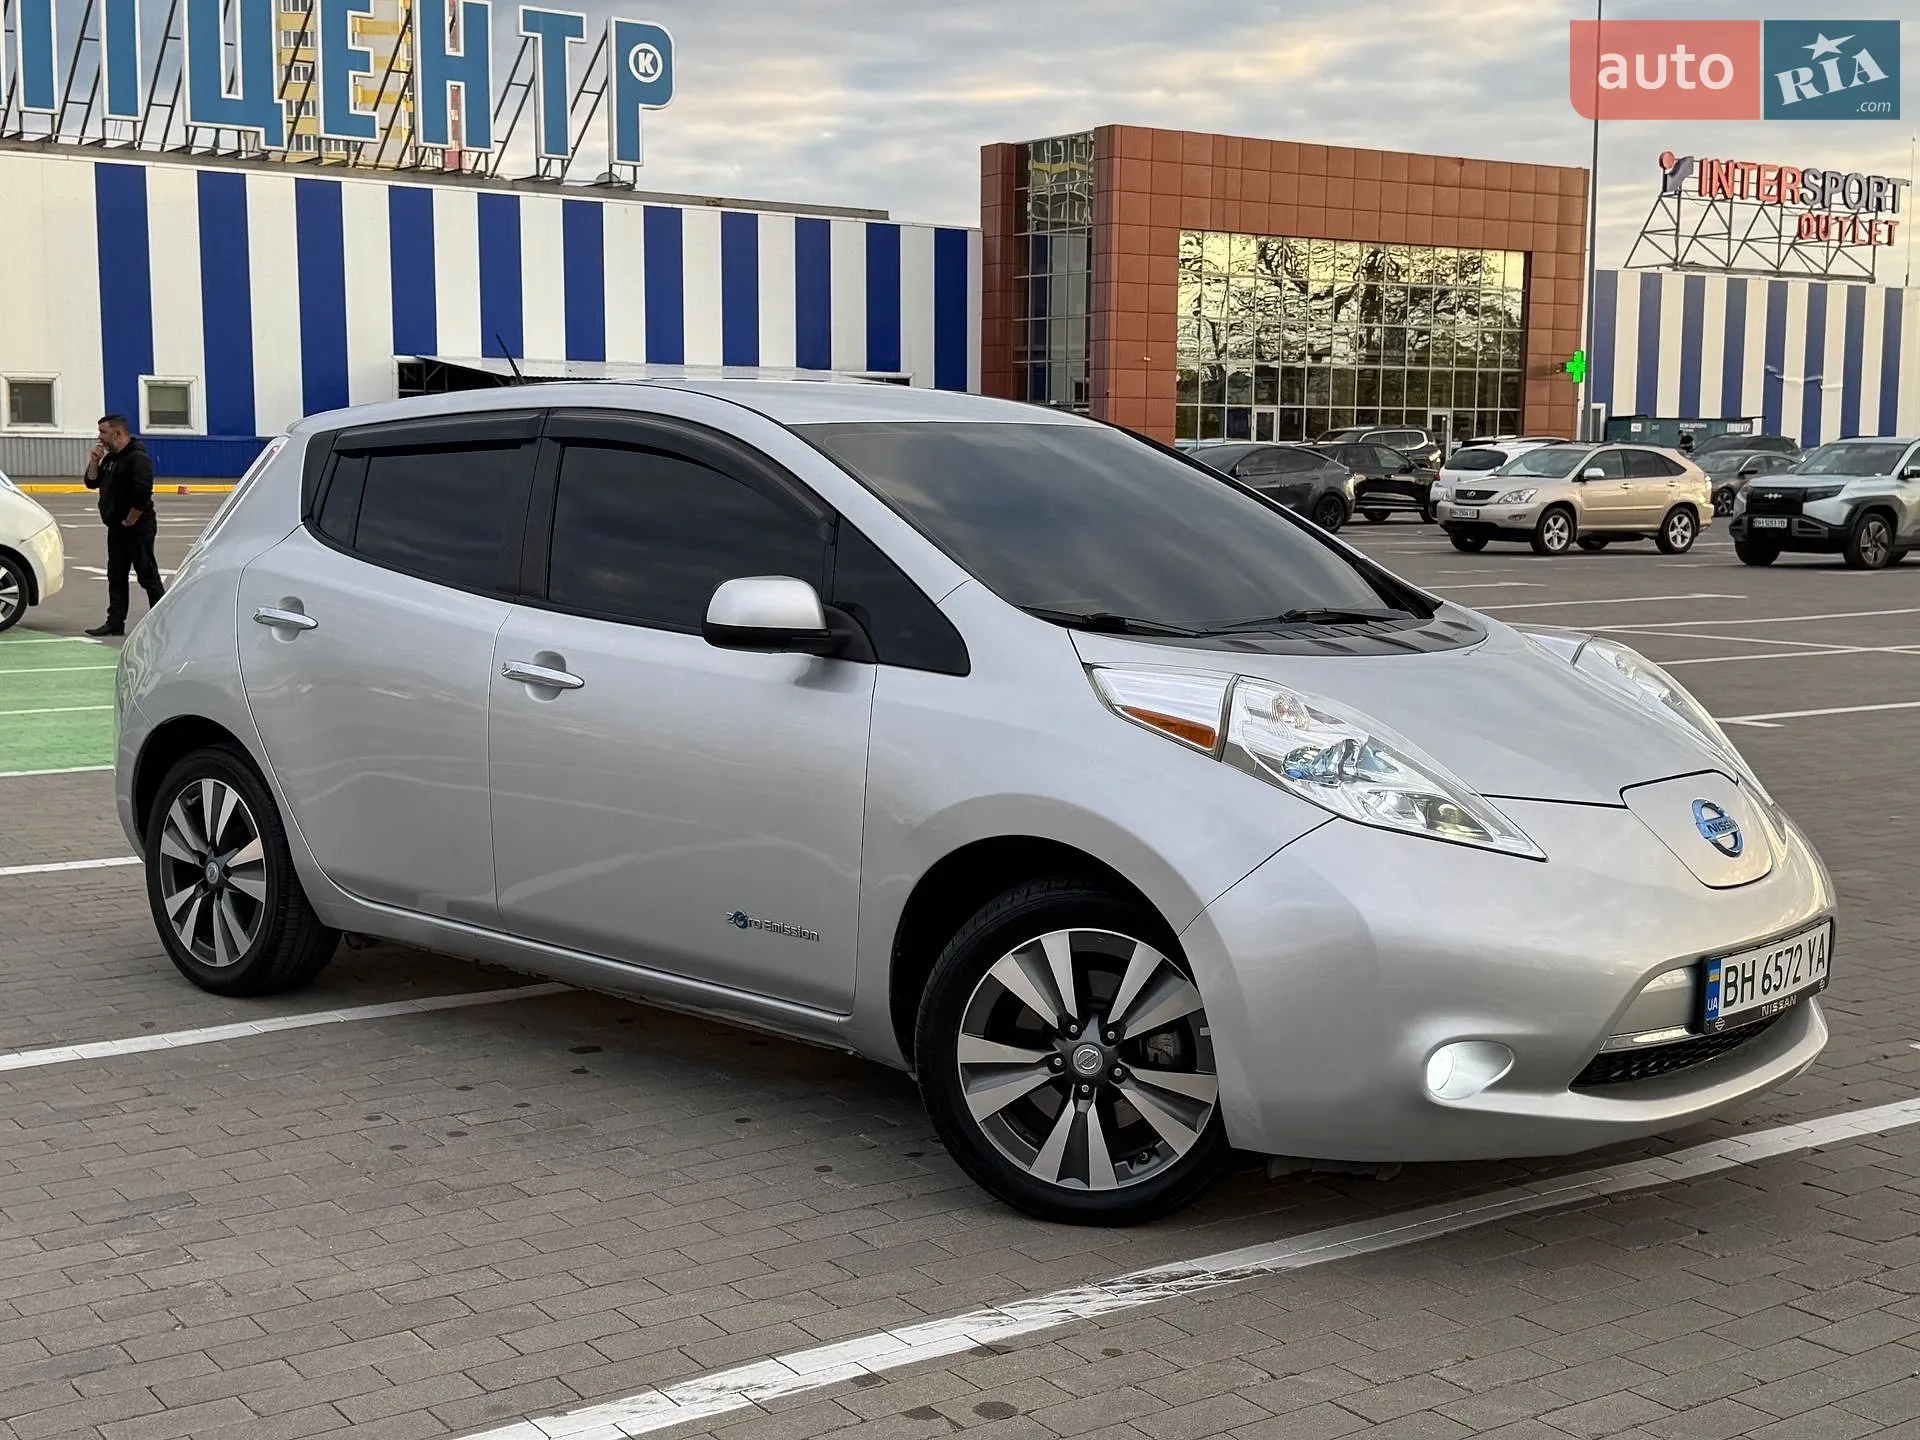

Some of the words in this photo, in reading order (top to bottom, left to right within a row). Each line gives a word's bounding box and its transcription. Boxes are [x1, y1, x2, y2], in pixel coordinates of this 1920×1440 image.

[1699, 157, 1910, 214] INTERSPORT
[1798, 211, 1900, 247] OUTLET
[1723, 959, 1756, 1009] BH
[1761, 943, 1803, 996] 6572
[1808, 932, 1826, 977] YA
[1707, 996, 1718, 1011] UA
[1761, 994, 1797, 1017] NISSAN
